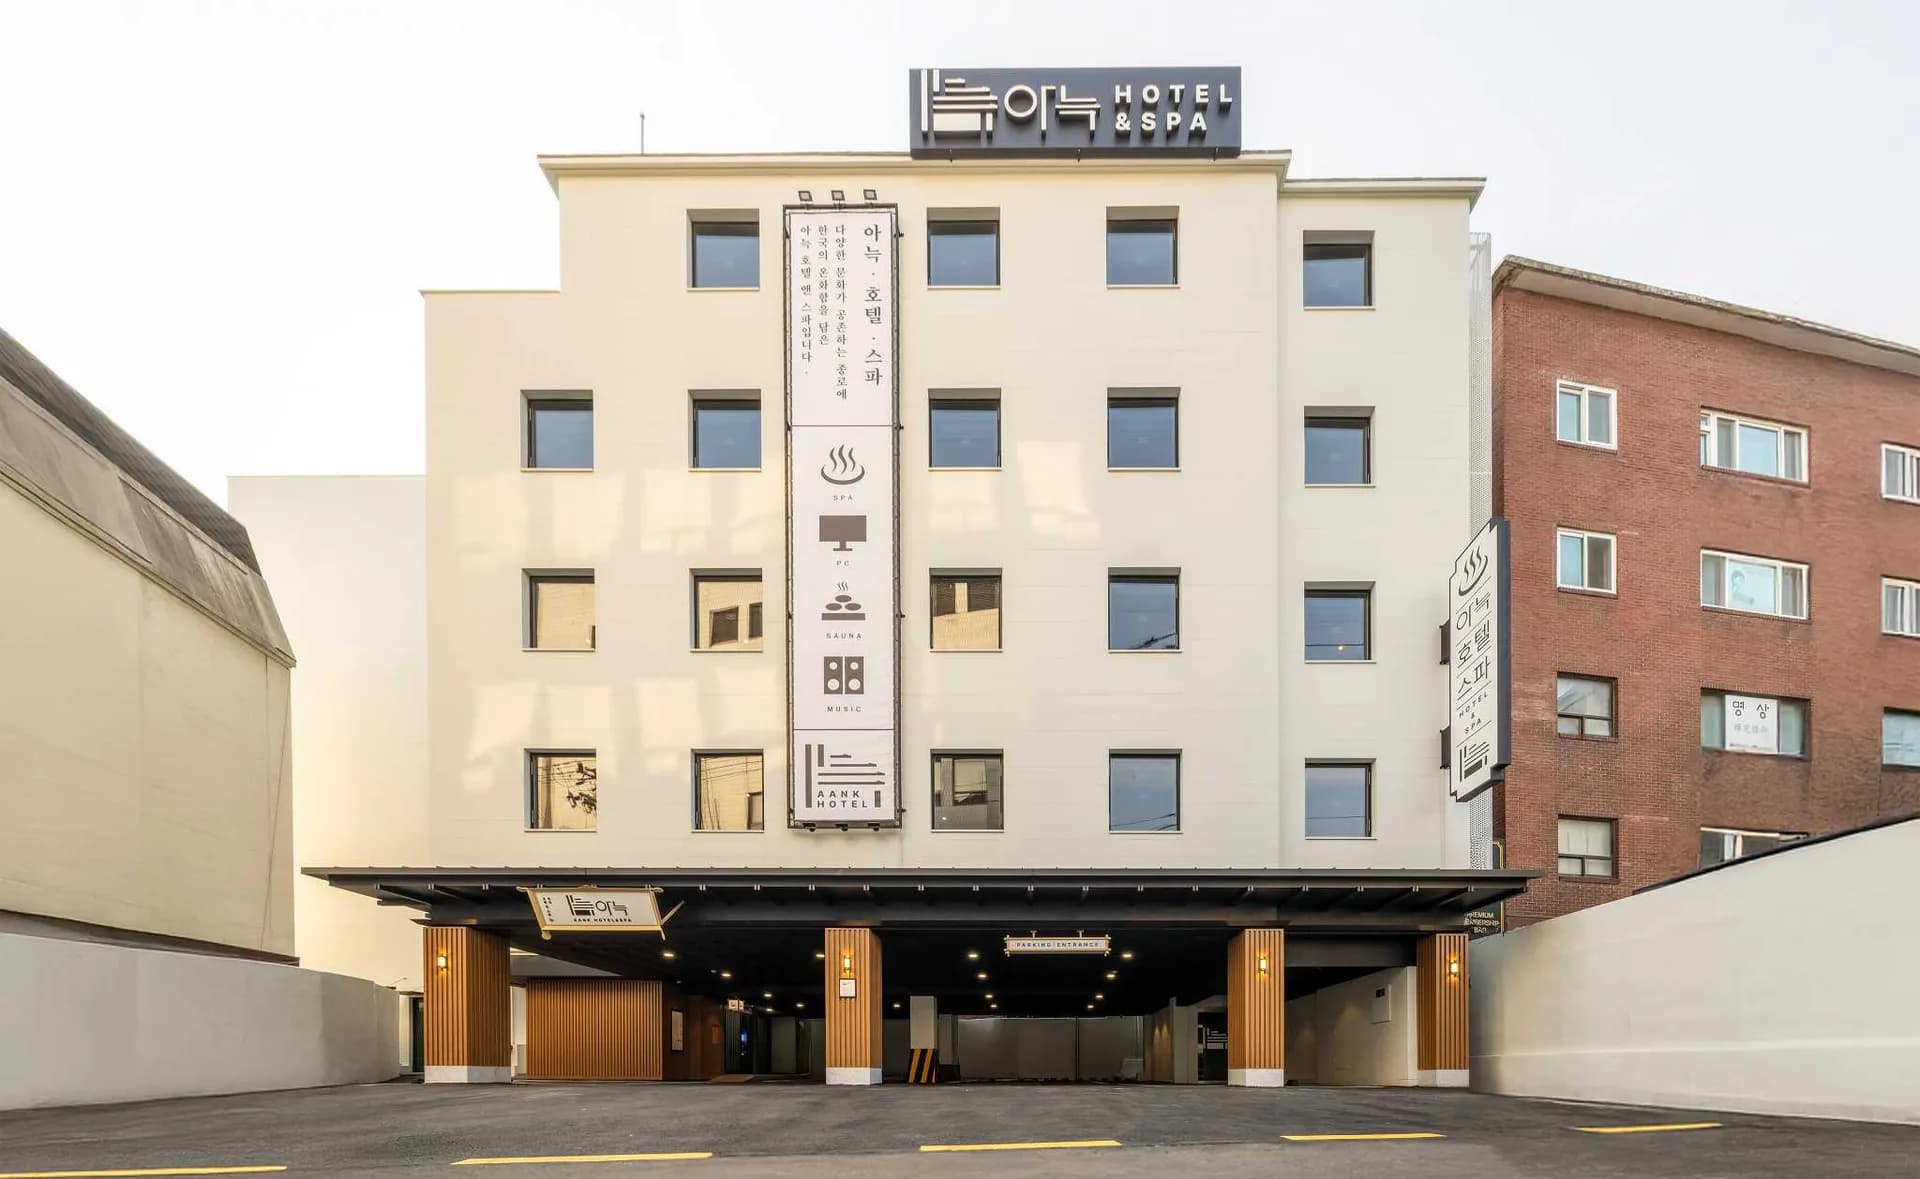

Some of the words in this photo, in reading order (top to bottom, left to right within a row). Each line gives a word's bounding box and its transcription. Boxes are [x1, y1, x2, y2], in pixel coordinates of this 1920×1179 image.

[1114, 83, 1233, 105] HOTEL
[1114, 111, 1209, 133] &SPA
[835, 224, 847, 261] 다양한
[1457, 619, 1490, 669] 호텔
[1457, 655, 1491, 701] 스파
[1459, 691, 1488, 719] HOTEL
[1464, 718, 1482, 735] SPA
[817, 790, 860, 798] AANK
[817, 800, 868, 808] HOTEL
[1464, 917, 1500, 927] EMBERSHIP
